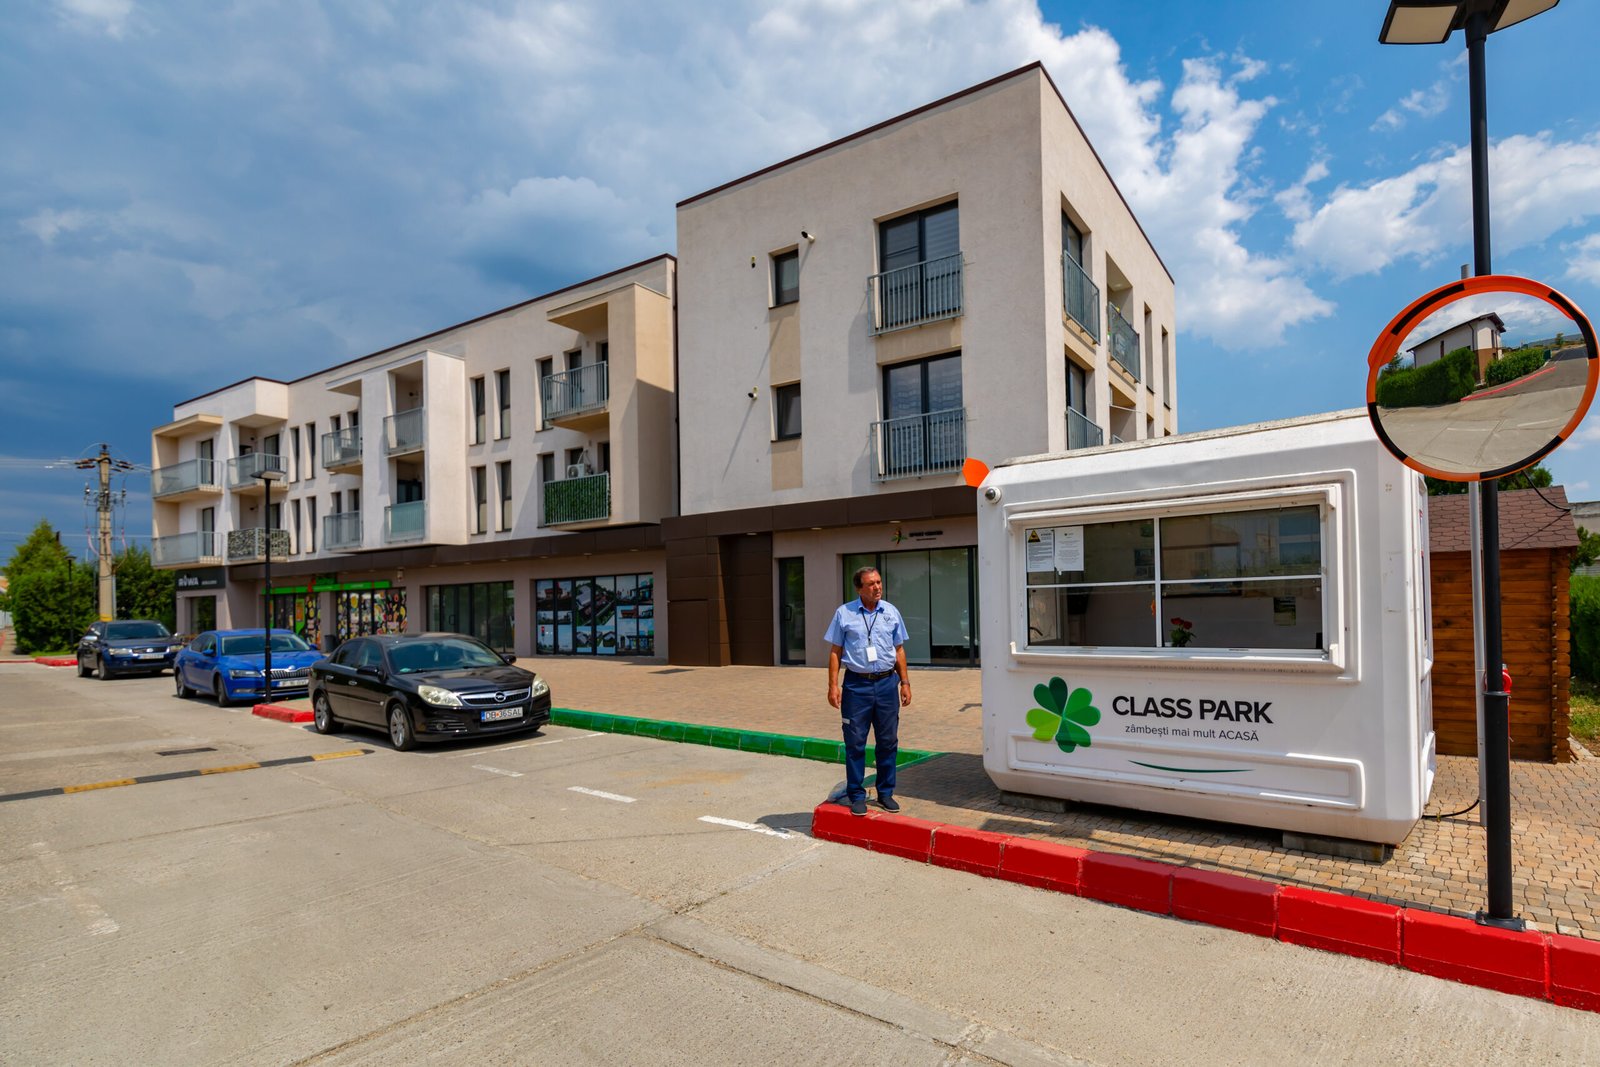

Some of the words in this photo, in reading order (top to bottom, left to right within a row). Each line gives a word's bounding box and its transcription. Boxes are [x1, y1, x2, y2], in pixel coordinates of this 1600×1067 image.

[1112, 696, 1193, 719] CLASS
[1199, 699, 1274, 724] PARK
[1125, 725, 1169, 737] zâmbești
[1171, 728, 1190, 737] mai
[1193, 729, 1216, 739] mult
[1219, 730, 1259, 741] ACASĂ
